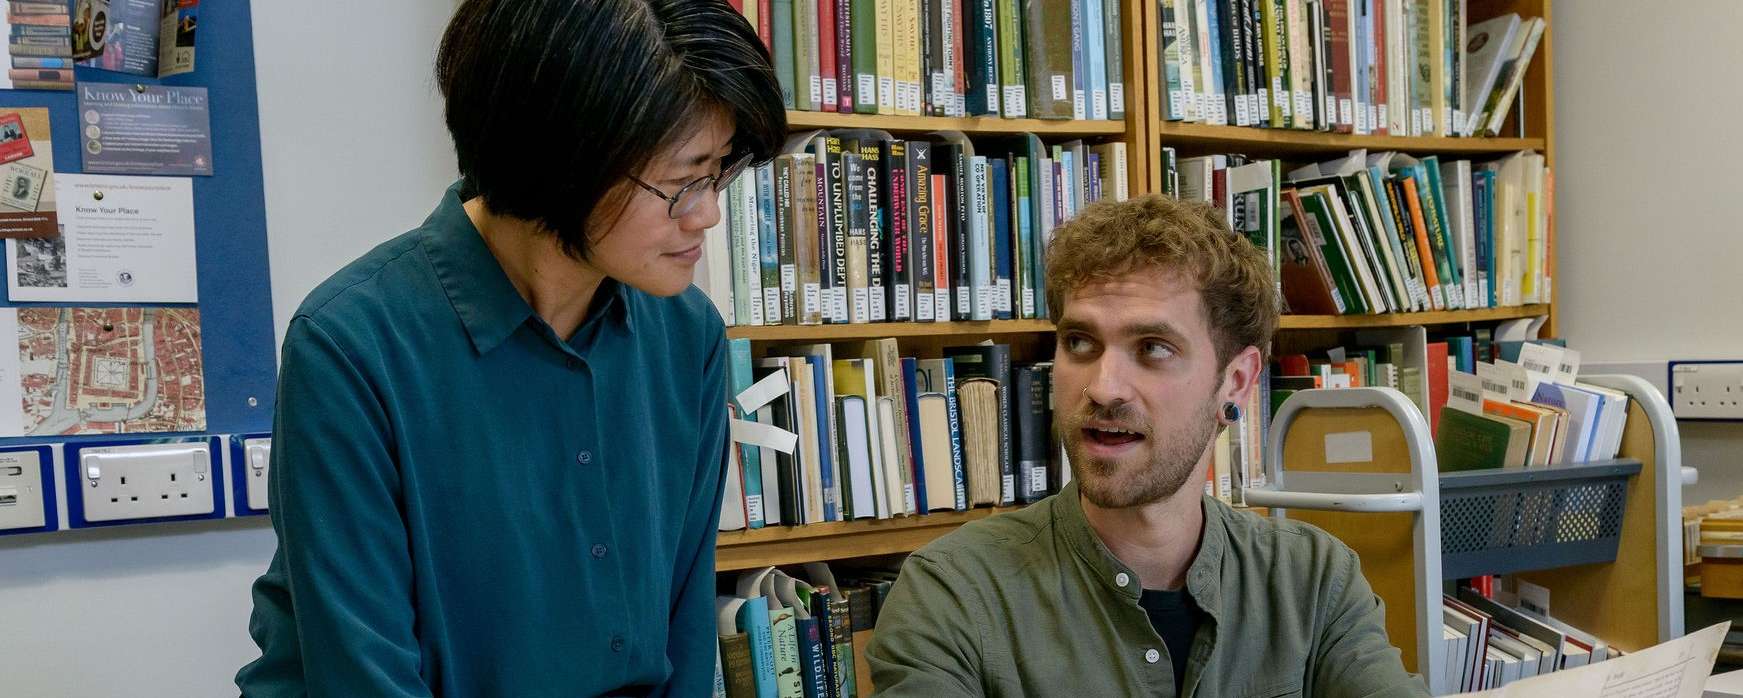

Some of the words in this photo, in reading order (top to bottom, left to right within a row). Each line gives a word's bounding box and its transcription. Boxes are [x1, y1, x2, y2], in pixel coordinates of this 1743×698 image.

[984, 8, 993, 30] 1807
[1233, 29, 1241, 60] BIRDS
[84, 86, 125, 102] Know
[128, 88, 163, 103] Your
[166, 90, 203, 105] Place
[861, 146, 880, 154] HANS
[862, 153, 880, 161] HASS
[832, 160, 841, 179] TO
[848, 174, 863, 182] come
[849, 163, 861, 172] We
[848, 183, 863, 191] from
[915, 165, 928, 203] Amazing
[817, 177, 825, 227] MOUNTAIN
[851, 192, 862, 200] the
[892, 168, 900, 235] UNDERWATER
[747, 196, 756, 236] Mastering
[867, 167, 880, 249] CHALLENGING
[833, 183, 845, 256] UNPLUMBED
[849, 228, 866, 236] HANS
[751, 253, 759, 274] Niger
[837, 258, 847, 287] DEPT
[872, 252, 881, 275] THE
[946, 375, 956, 396] THE
[948, 397, 959, 437] BRISTOL
[952, 438, 964, 486] LANDSCA
[787, 623, 794, 631] A
[777, 630, 787, 662] Nature
[788, 634, 796, 651] Life
[811, 643, 824, 698] WILDLIFE
